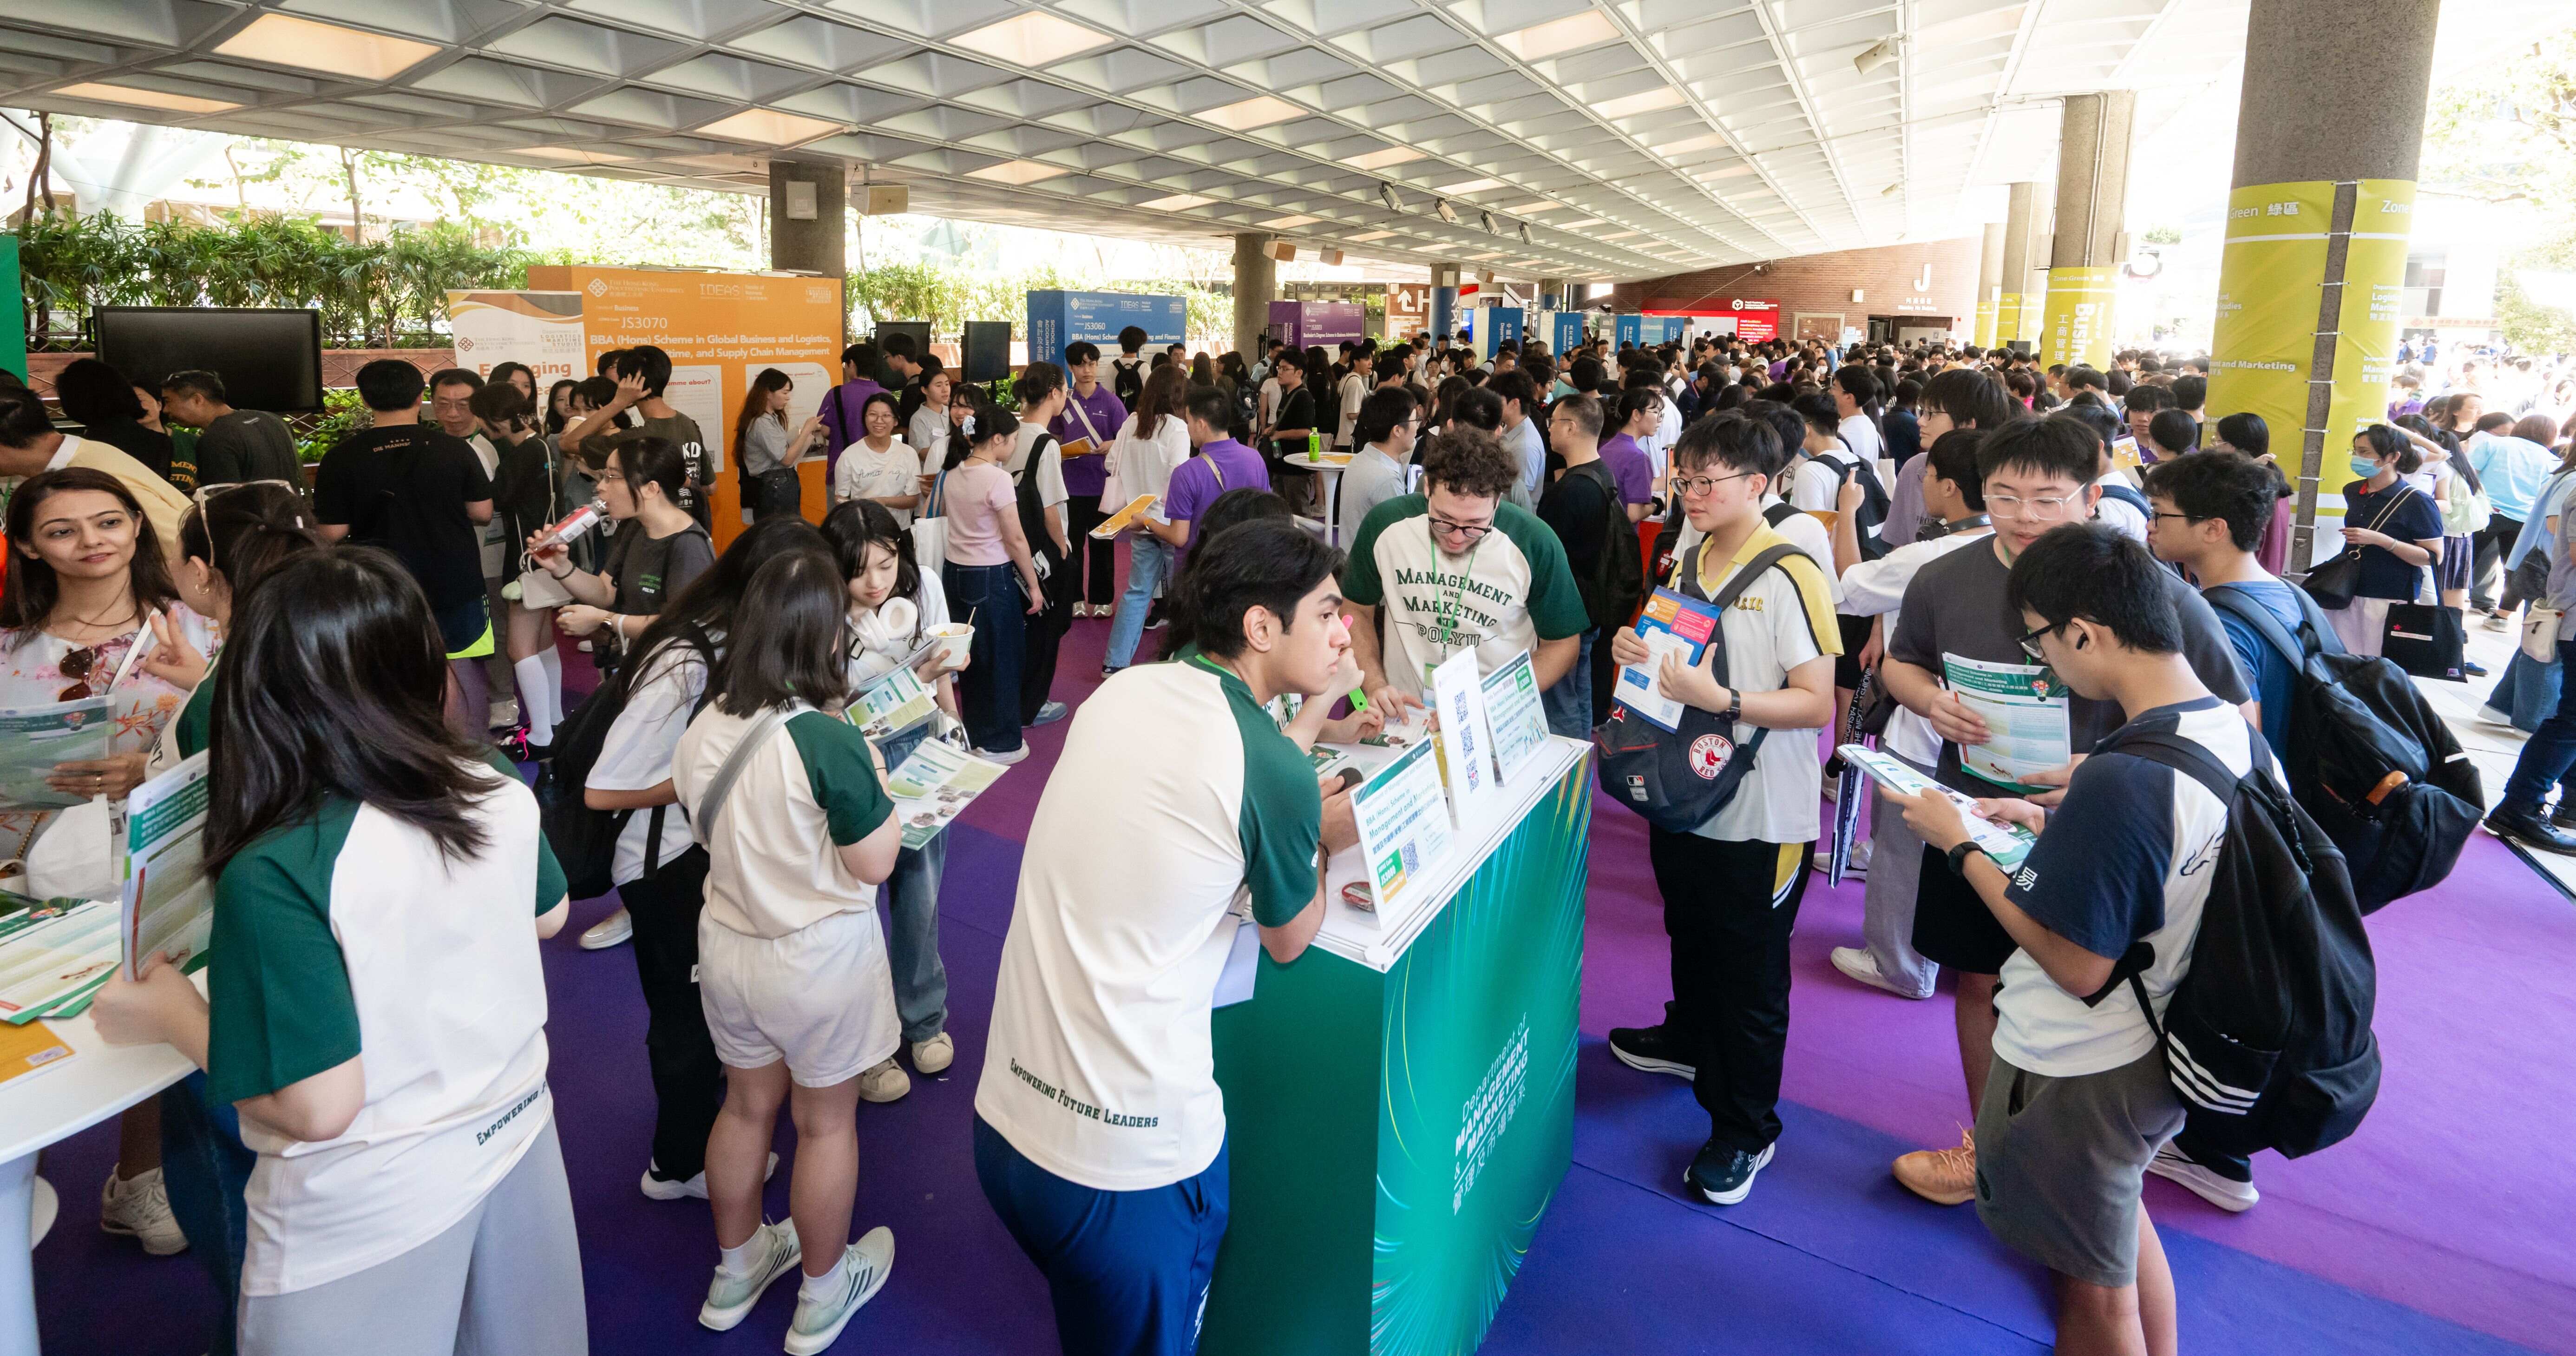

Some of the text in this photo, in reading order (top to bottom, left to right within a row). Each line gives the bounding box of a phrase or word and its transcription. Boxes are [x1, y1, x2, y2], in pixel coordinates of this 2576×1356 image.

[2267, 202, 2300, 216] 綠區
[2381, 200, 2410, 213] Zone
[1913, 263, 1931, 292] J
[700, 283, 740, 296] IDEAS
[1121, 301, 1139, 309] IDEAS
[621, 317, 668, 329] JS3070
[590, 334, 832, 346] BBA (Hons) Scheme in Global Business and Logistics,
[2054, 314, 2070, 361] 工商管理
[2069, 303, 2095, 366] Busine
[666, 348, 830, 361] itime, and Supply Chain Management
[1051, 347, 1055, 355] OF
[479, 362, 571, 379] Eging
[2238, 361, 2296, 372] Marketing
[858, 468, 902, 484] Amang
[1395, 568, 1513, 606] MANAGEMENT
[1442, 590, 1460, 599] AND
[1403, 596, 1497, 627] MARKETING
[1693, 737, 1726, 754] BOSTON
[1698, 765, 1714, 777] RED
[1366, 815, 1376, 827] BBA
[1376, 803, 1390, 820] (Hons)
[1390, 792, 1405, 808] Scheme
[1369, 781, 1436, 841] Management and Marketing
[1462, 1011, 1527, 1123] Department of
[1010, 1057, 1159, 1128] EMPOWERING FUTURE LEADERS
[1455, 1027, 1530, 1157] MANAGEMENT
[476, 1090, 538, 1146] EMPOWERING
[1454, 1049, 1528, 1180] & MARKETING
[1452, 1078, 1526, 1216] 管理及市場學系
